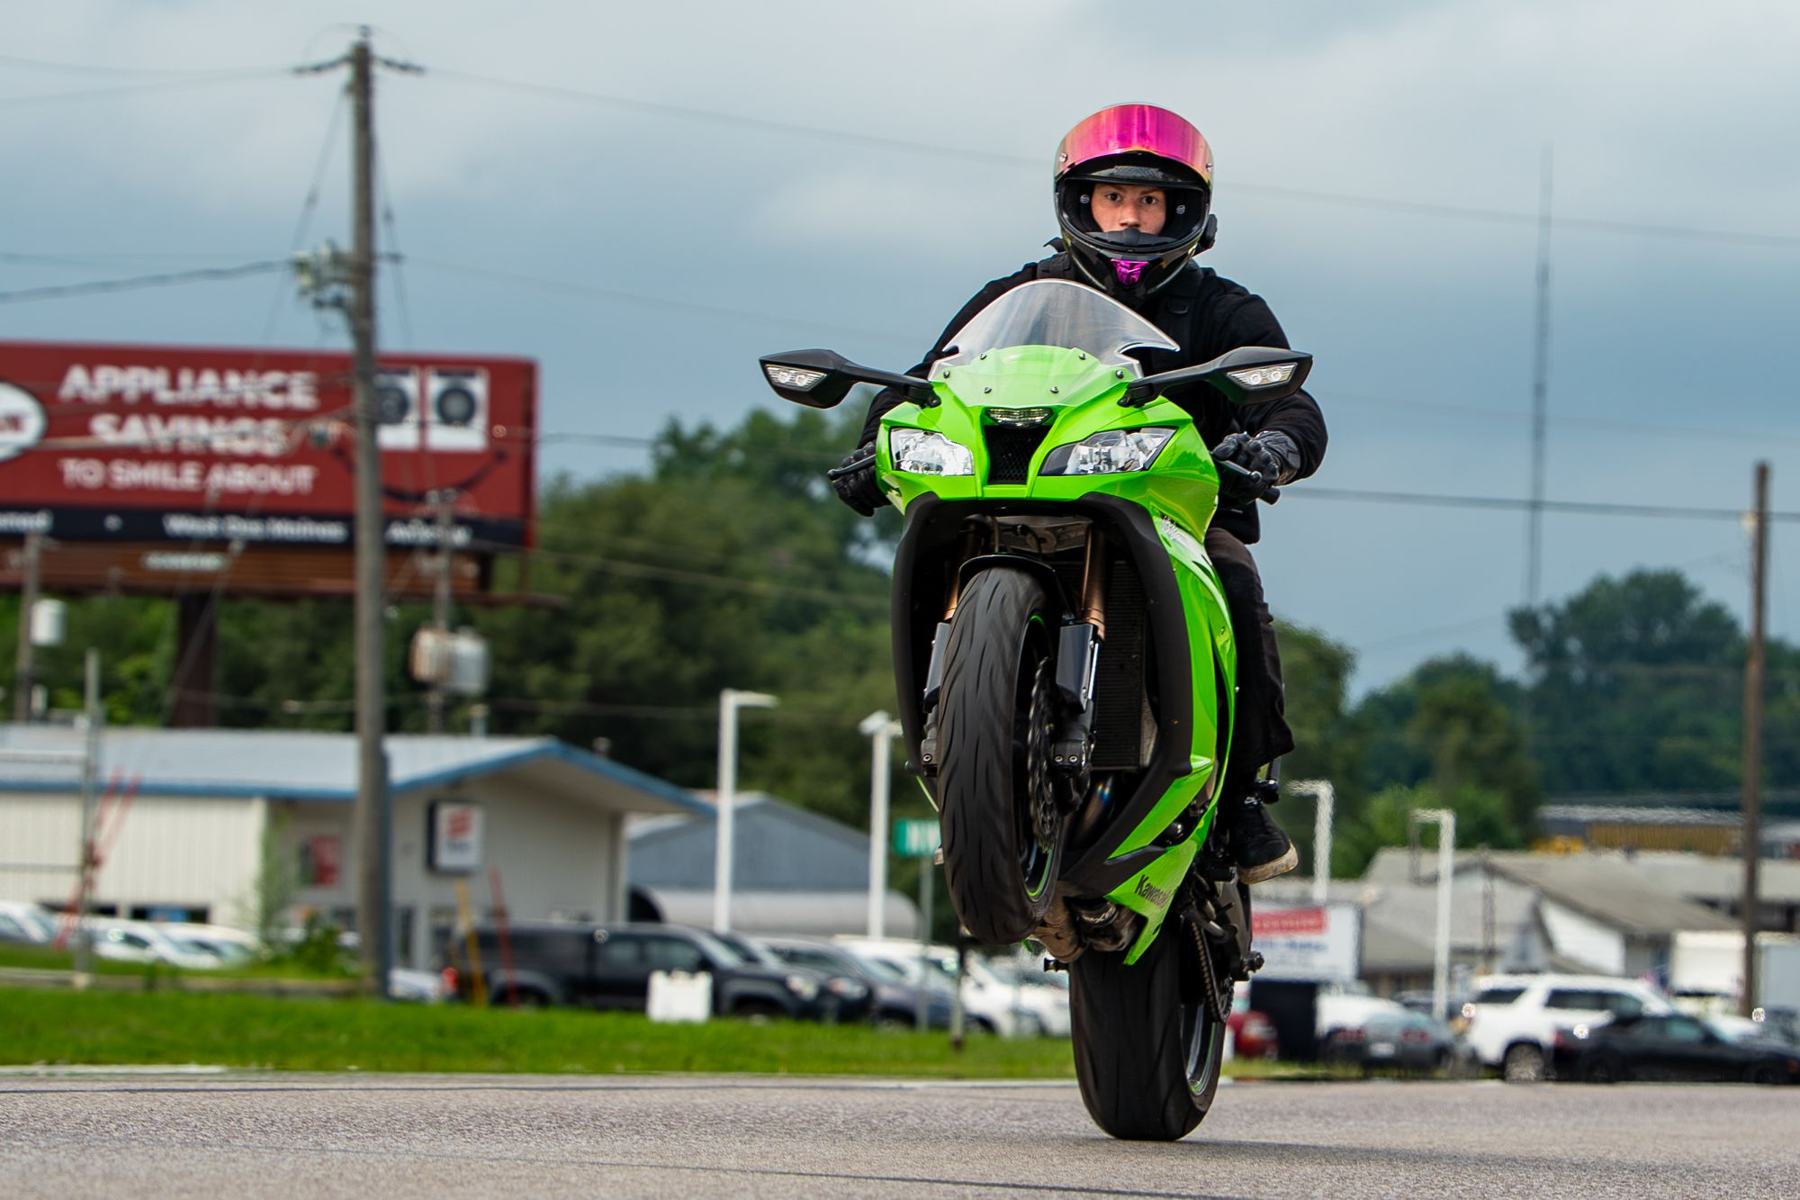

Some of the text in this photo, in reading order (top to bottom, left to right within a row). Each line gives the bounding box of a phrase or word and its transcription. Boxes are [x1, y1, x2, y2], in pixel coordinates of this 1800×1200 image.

[58, 364, 320, 411] APPLIANCE
[88, 413, 288, 457] SAVINGS
[58, 457, 318, 496] TO SMILE ABOUT
